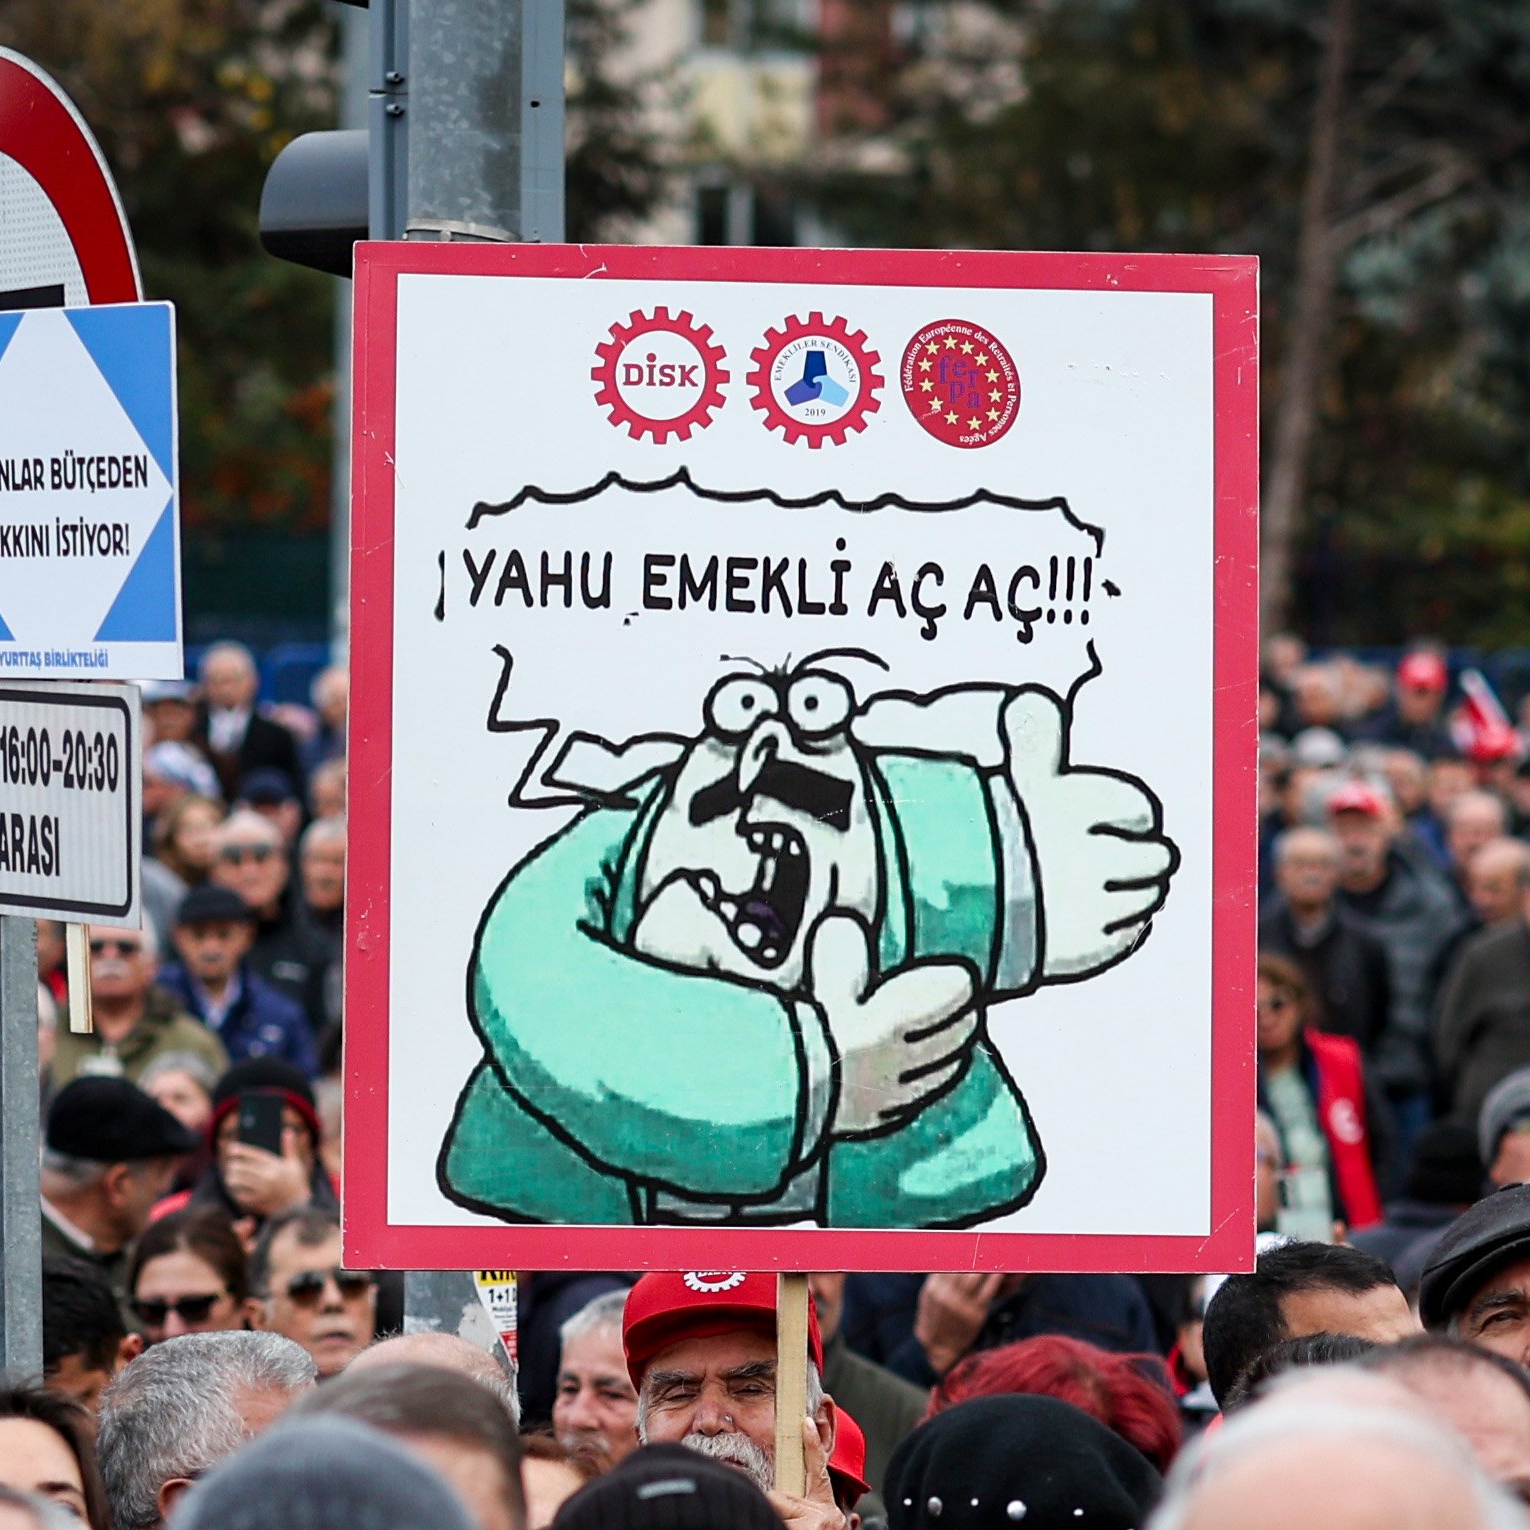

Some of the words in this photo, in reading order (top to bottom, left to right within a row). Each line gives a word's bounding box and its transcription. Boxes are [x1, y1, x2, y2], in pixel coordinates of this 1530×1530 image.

[623, 353, 699, 387] DİSK
[774, 339, 818, 382] EMEKLİLER
[820, 340, 857, 383] SENDİKASI
[918, 323, 973, 344] Européenne
[974, 331, 990, 345] des
[1007, 383, 1016, 392] et
[804, 408, 827, 417] 2019
[50, 449, 148, 493] BÜTÇEDEN
[55, 516, 130, 557] İSTİYOR!
[463, 548, 613, 610] YAHU
[642, 537, 852, 618] EMEKLİ
[866, 561, 947, 641] AÇ
[963, 554, 1093, 645] AÇ!!!
[44, 648, 109, 668] BİRLİKTELİĞİ
[0, 724, 119, 793] 16:00-20:30
